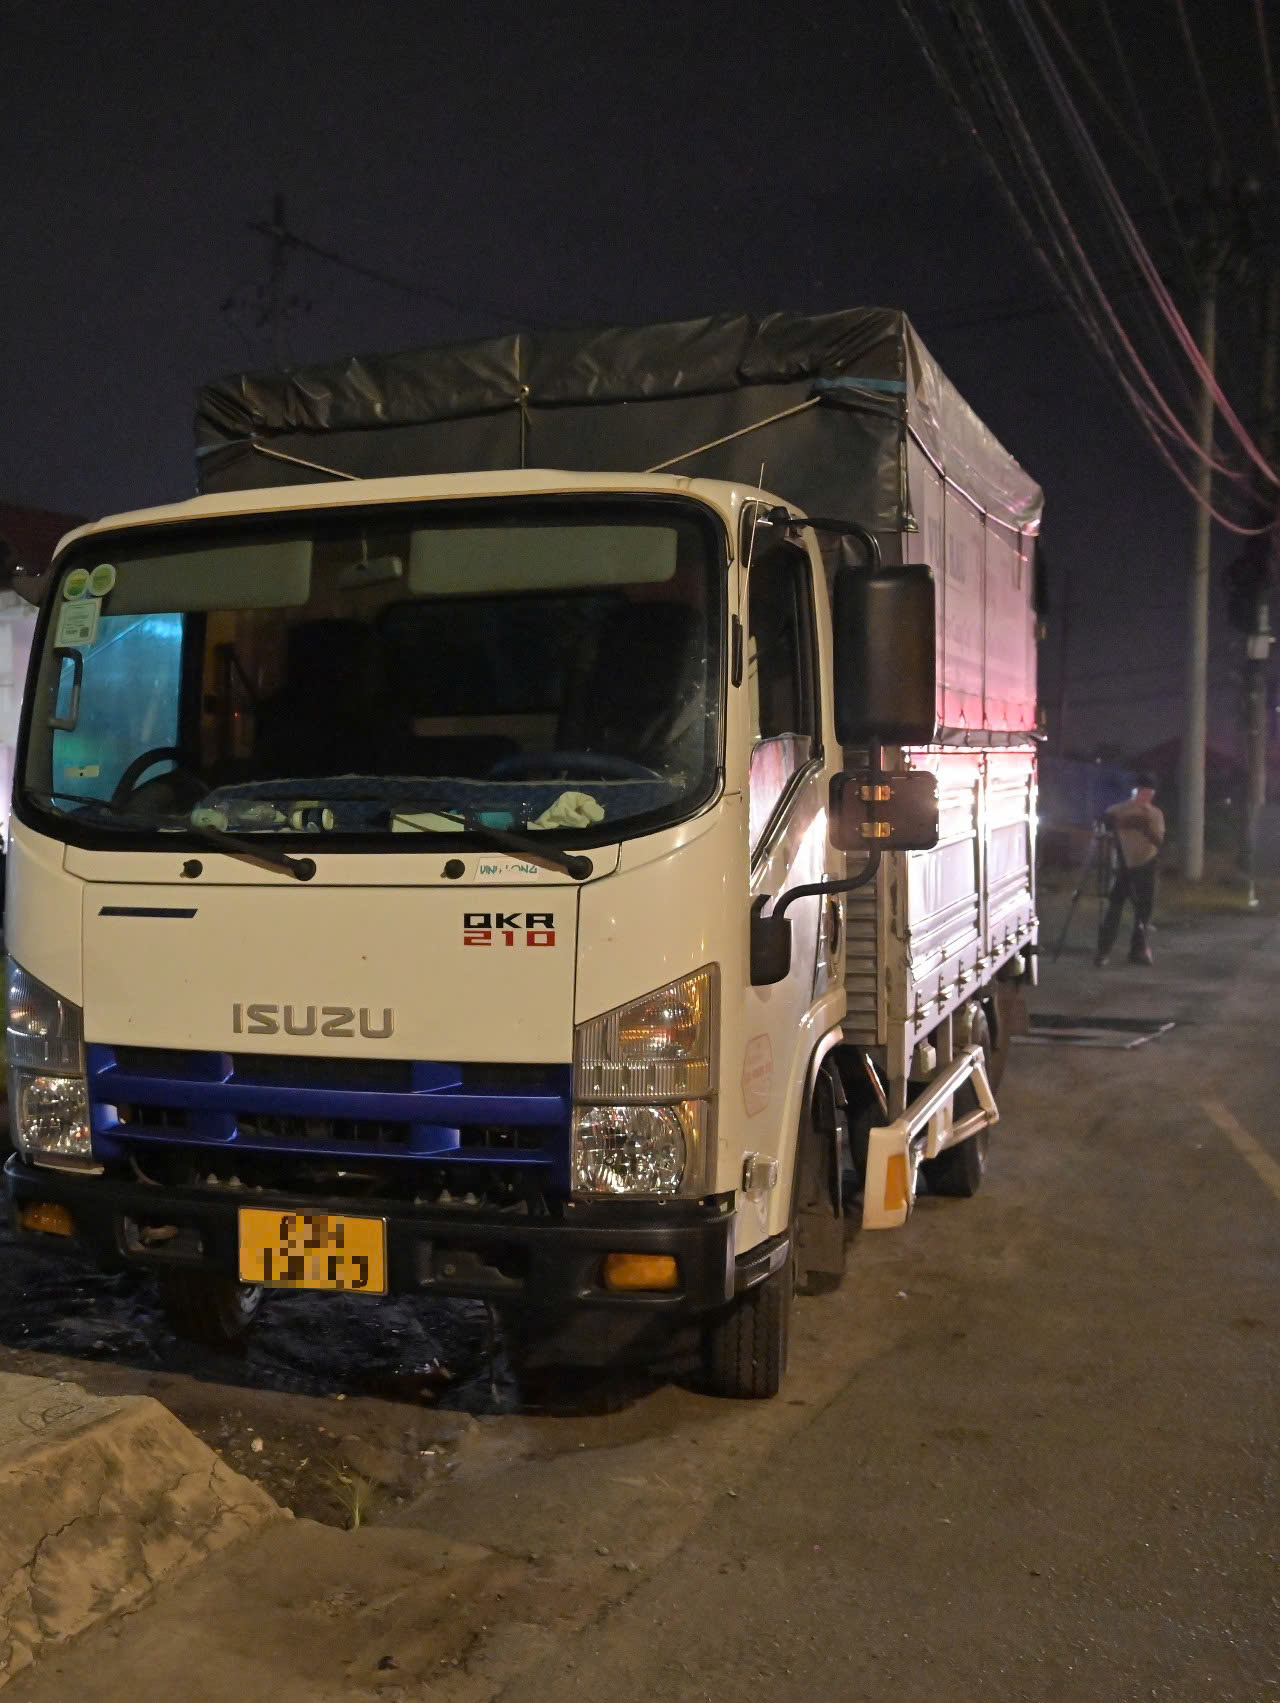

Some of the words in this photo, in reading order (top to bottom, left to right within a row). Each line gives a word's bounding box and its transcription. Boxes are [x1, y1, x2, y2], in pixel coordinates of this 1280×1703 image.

[463, 912, 555, 929] QKR
[463, 930, 556, 947] 210
[232, 1002, 395, 1039] ISUZU
